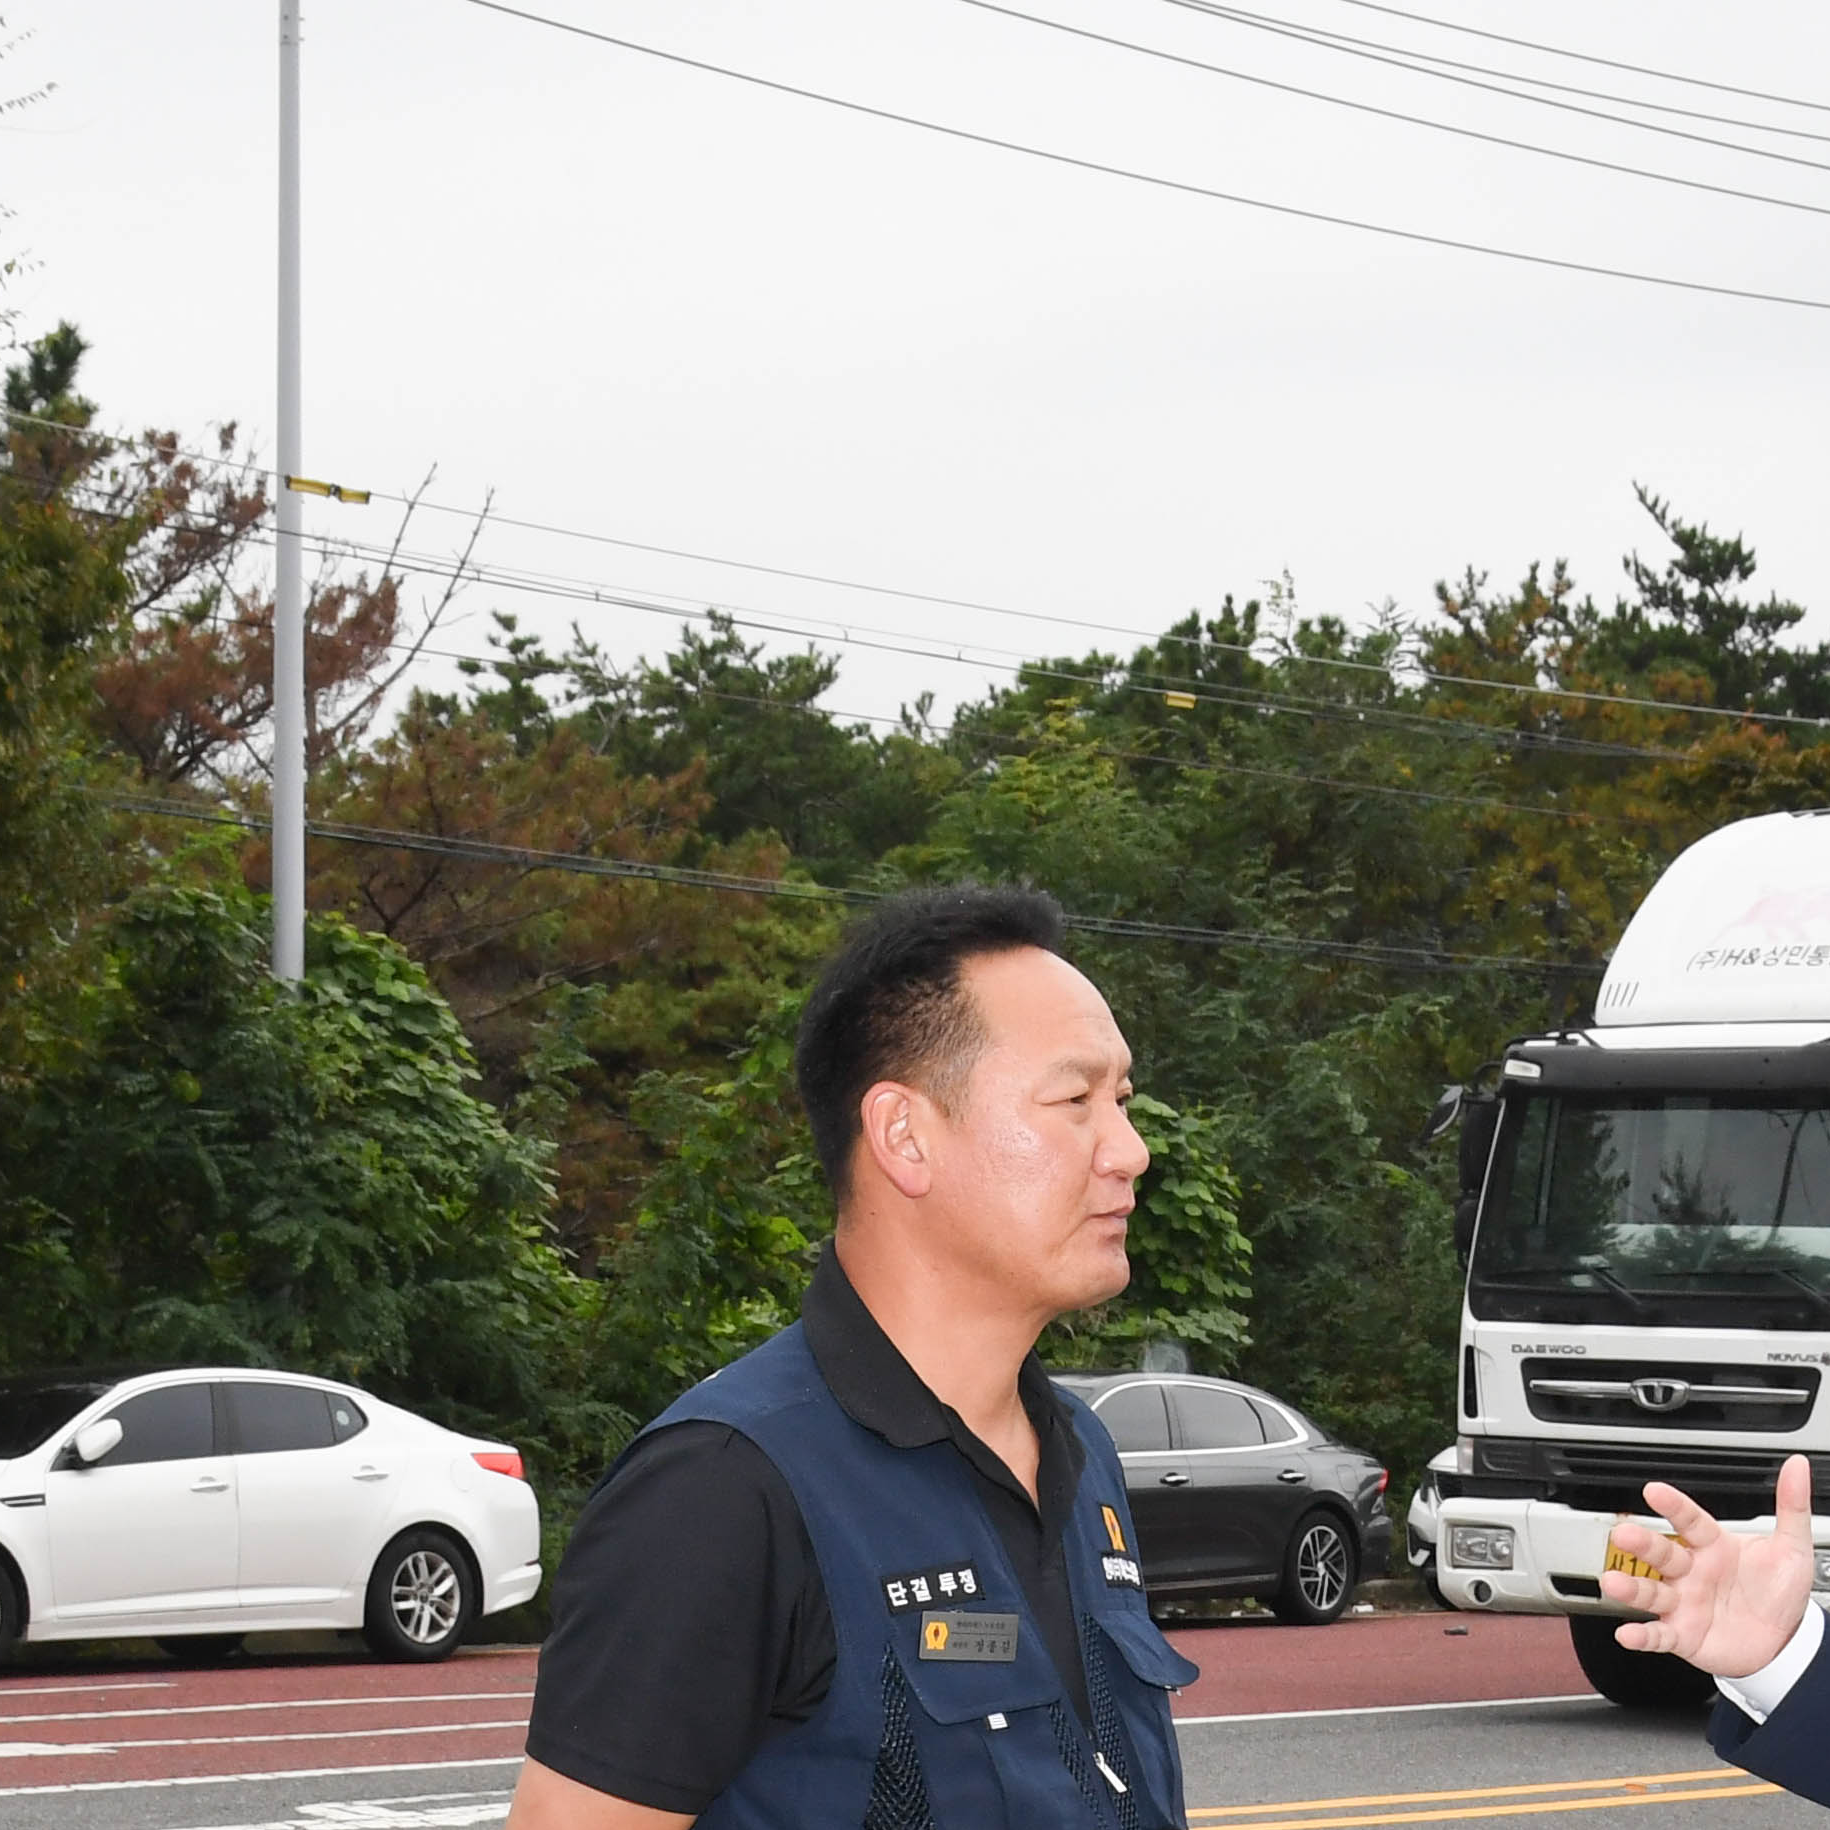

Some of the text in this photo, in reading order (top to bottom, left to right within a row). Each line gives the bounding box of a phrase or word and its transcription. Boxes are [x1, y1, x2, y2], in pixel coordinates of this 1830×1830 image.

[1511, 1343, 1587, 1355] DAEWOO
[1767, 1352, 1819, 1363] NOVUS
[886, 1568, 977, 1607] 단결 투쟁
